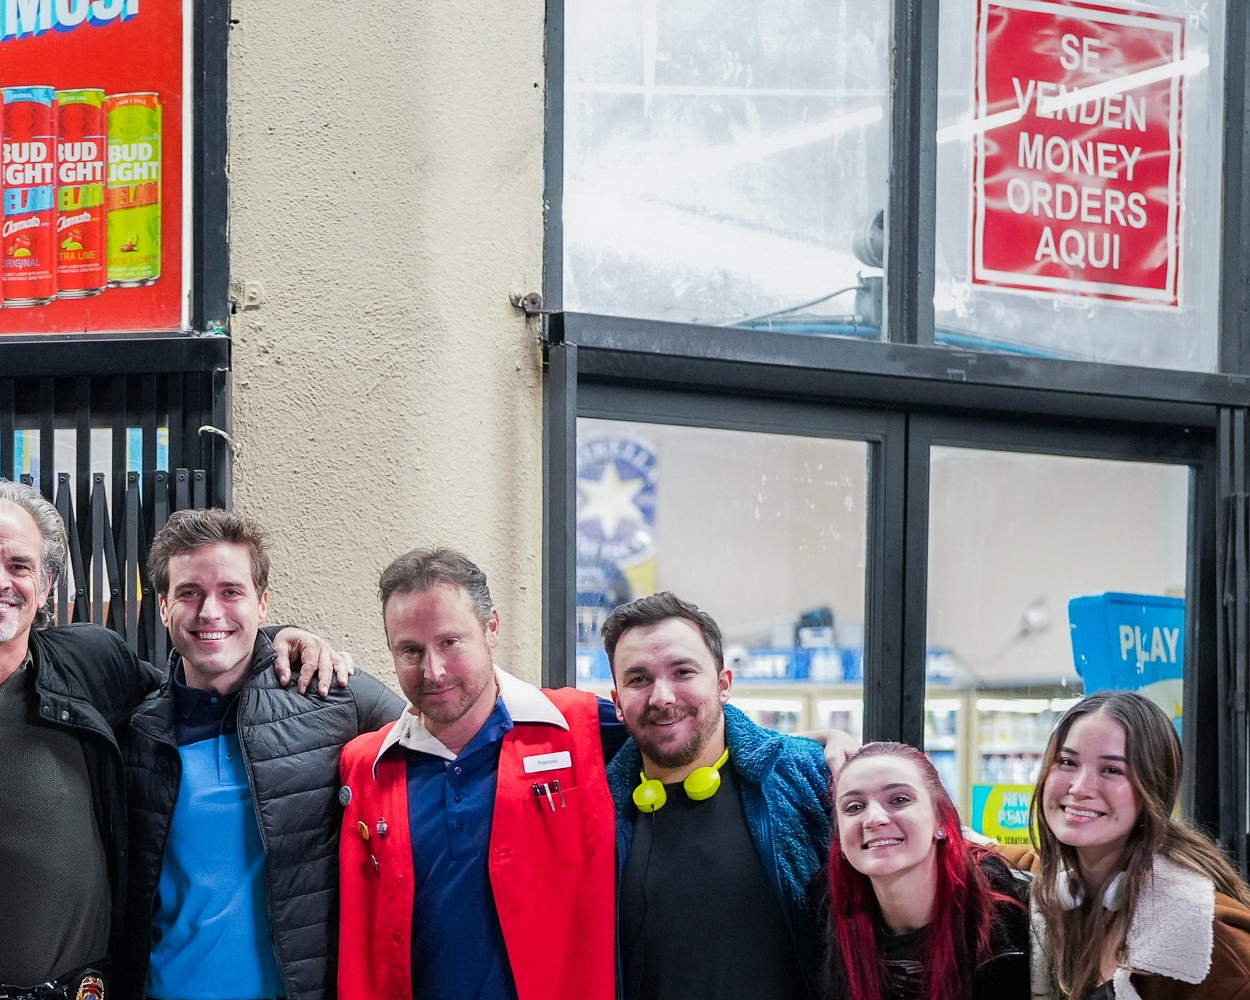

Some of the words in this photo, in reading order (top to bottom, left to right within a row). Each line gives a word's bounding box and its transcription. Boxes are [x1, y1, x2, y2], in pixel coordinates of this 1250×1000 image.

[1059, 33, 1101, 74] SE
[1011, 77, 1147, 132] VENDEN
[109, 142, 153, 163] BUD
[1017, 131, 1142, 181] MONEY
[1006, 177, 1148, 229] ORDERS
[2, 215, 41, 238] Clamato
[77, 250, 96, 260] LIME
[1034, 226, 1120, 270] AQUI
[1118, 624, 1179, 664] PLAY
